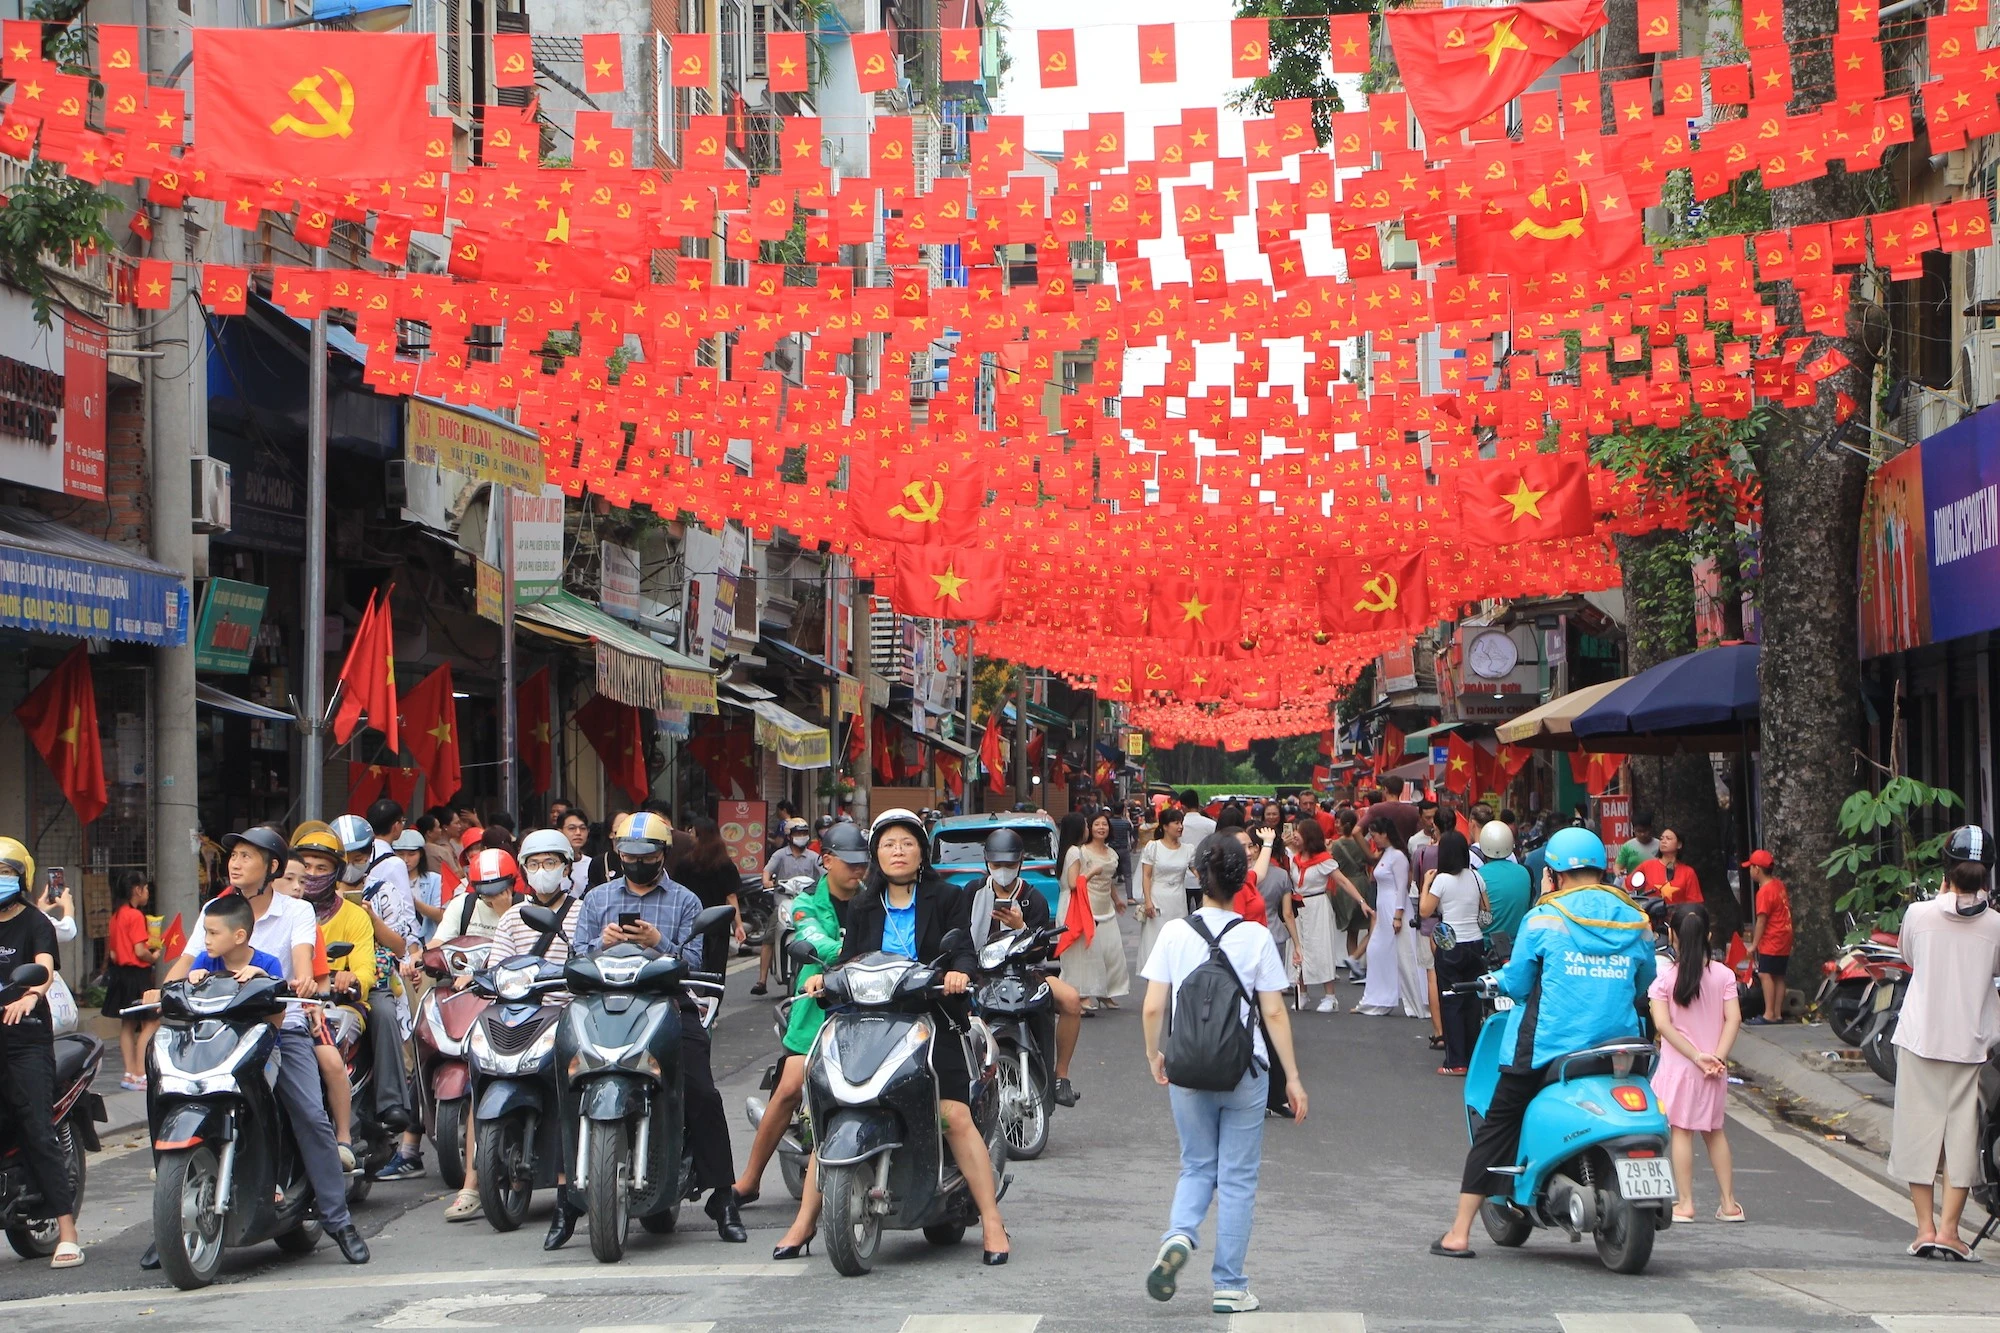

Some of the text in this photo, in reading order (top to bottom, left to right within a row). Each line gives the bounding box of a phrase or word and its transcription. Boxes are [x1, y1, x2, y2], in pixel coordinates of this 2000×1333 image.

[1466, 706, 1475, 715] 12
[1477, 703, 1504, 715] HÀNG
[1563, 951, 1630, 967] XANH SM
[1565, 964, 1628, 979] xin chào!
[1625, 1161, 1664, 1178] 29-BK
[1626, 1179, 1673, 1196] 140.73
